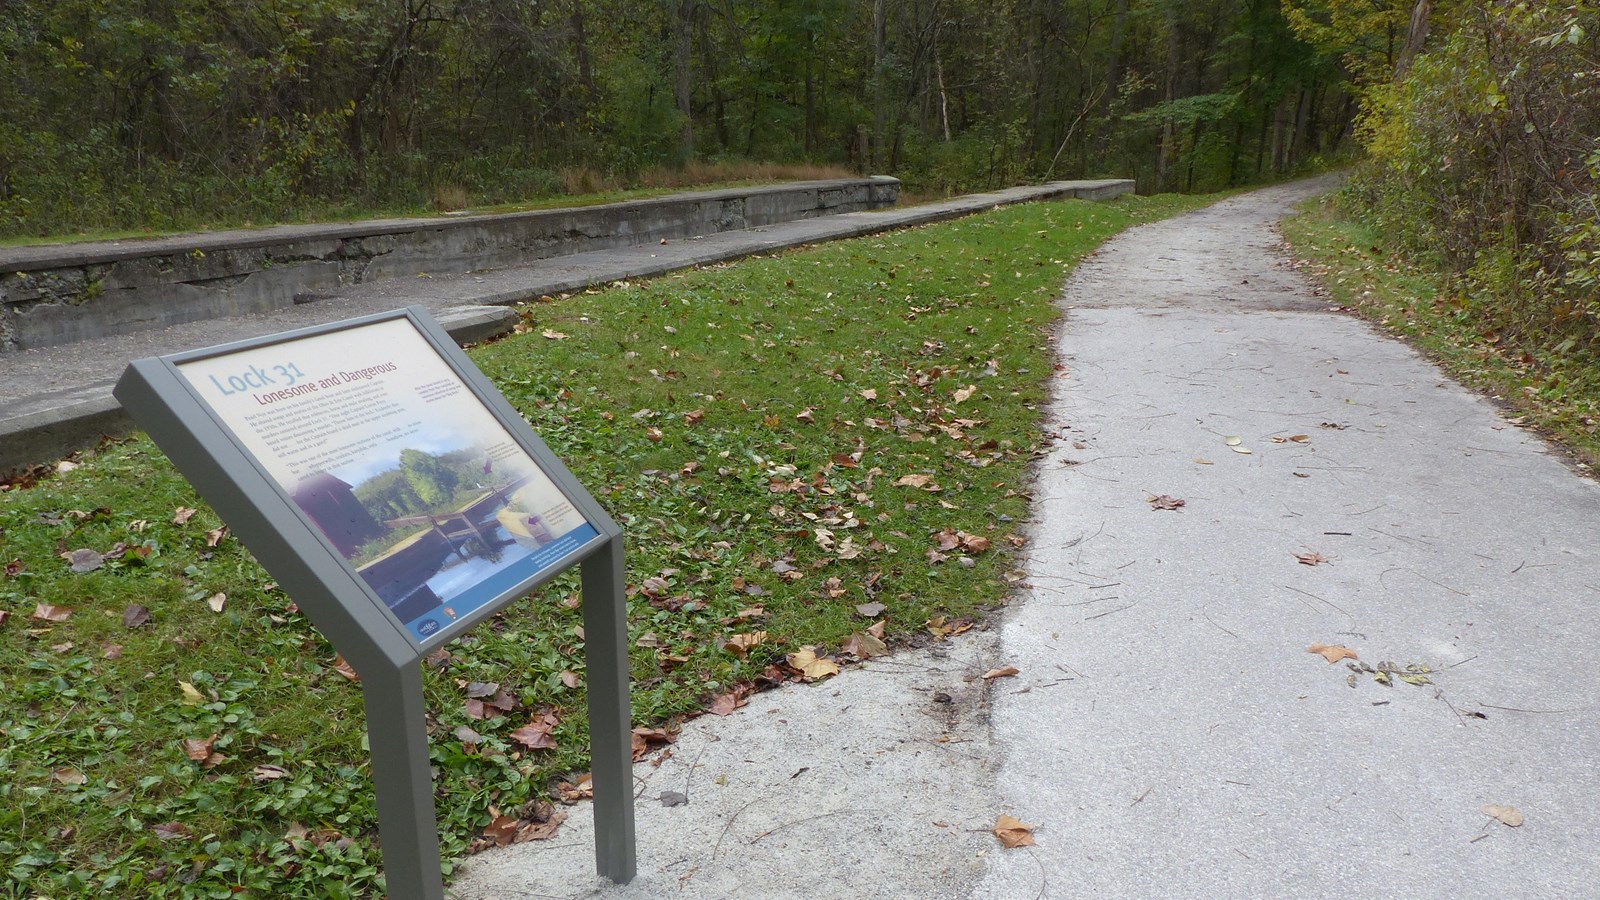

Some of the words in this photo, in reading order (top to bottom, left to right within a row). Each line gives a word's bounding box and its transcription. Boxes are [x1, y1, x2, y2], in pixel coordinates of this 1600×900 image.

[208, 365, 276, 396] Lock
[273, 361, 305, 386] 31
[253, 382, 319, 406] Lonesome
[320, 373, 341, 389] and
[340, 360, 398, 384] Dangerous
